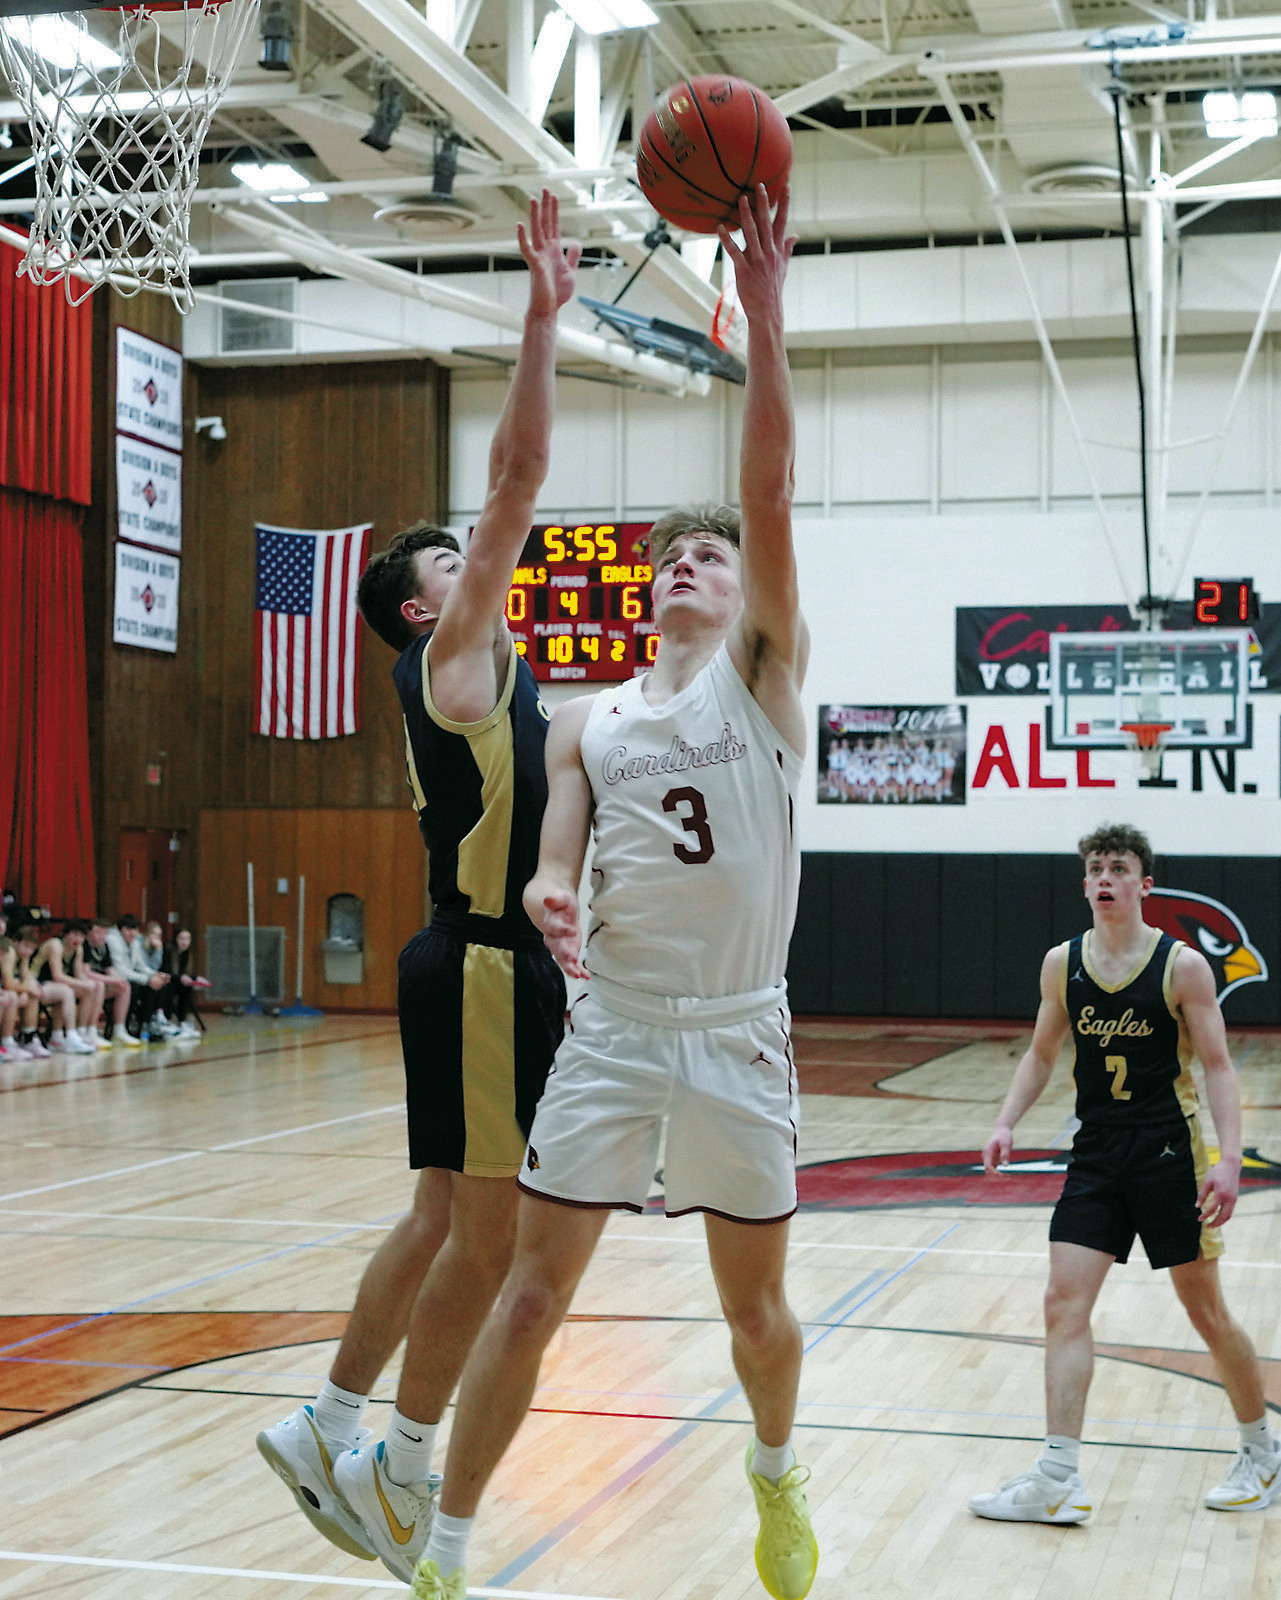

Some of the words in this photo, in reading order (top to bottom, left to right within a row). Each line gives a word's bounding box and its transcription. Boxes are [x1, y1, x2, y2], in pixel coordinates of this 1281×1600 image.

[543, 525, 617, 562] 5:55
[550, 575, 588, 588] PERIOD
[601, 565, 653, 583] EAGLES
[560, 591, 579, 616] 4
[1196, 581, 1248, 623] 21
[533, 623, 573, 636] PLAYER
[547, 635, 574, 663] 10
[580, 636, 599, 661] 4
[610, 639, 626, 662] 2
[602, 722, 747, 785] Cardinals
[972, 723, 1115, 788] ALL
[661, 786, 715, 864] 3
[1077, 1005, 1154, 1047] Eagles
[1105, 1055, 1132, 1101] 2
